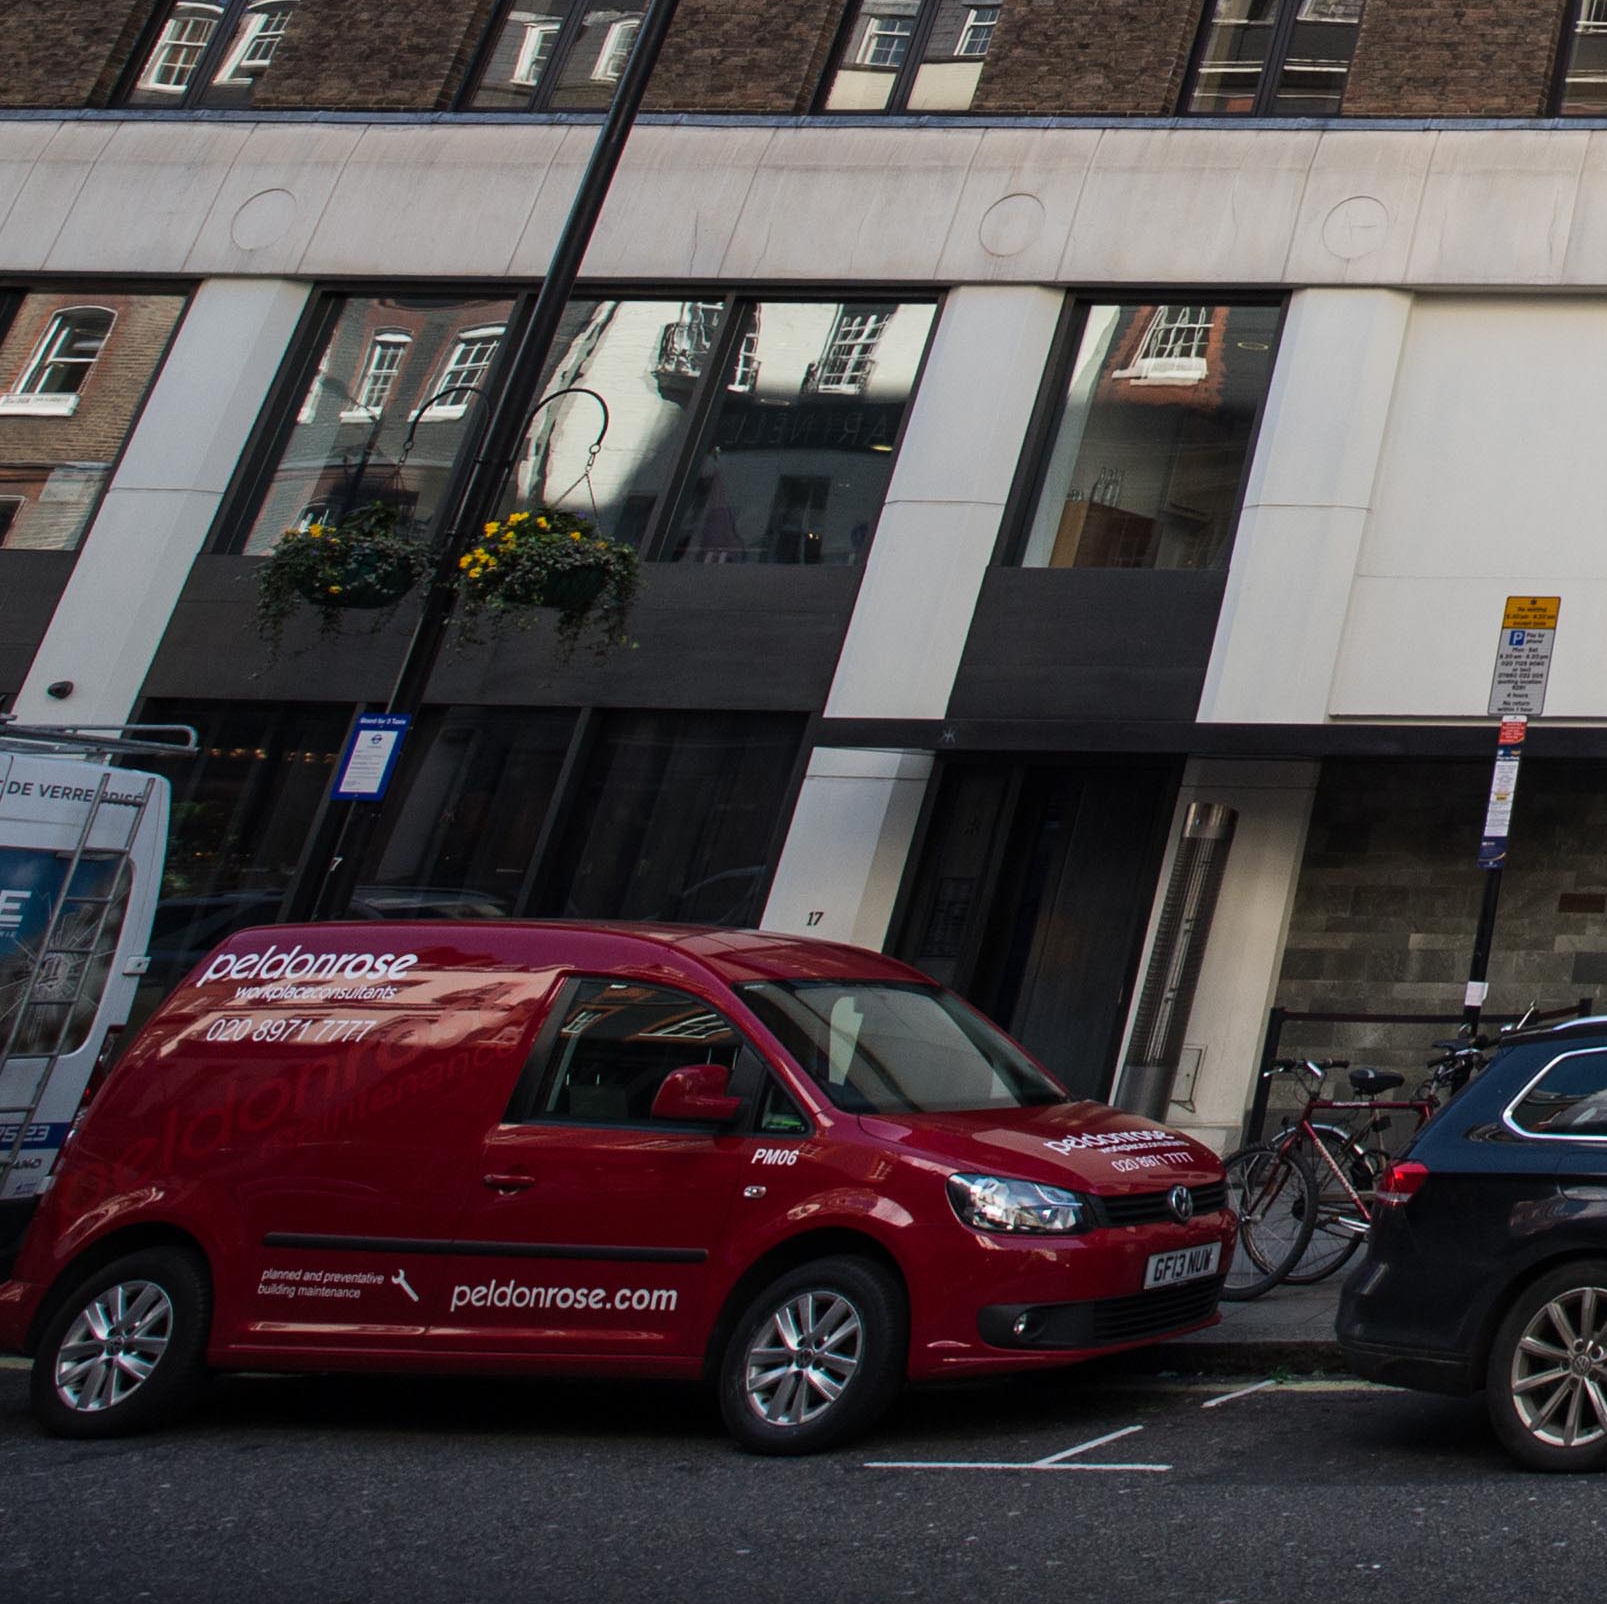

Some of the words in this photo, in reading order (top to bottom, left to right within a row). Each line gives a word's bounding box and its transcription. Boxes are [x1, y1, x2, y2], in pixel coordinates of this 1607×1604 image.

[7, 781, 34, 796] DE
[40, 784, 94, 803] VERRE
[806, 911, 824, 927] 17
[196, 945, 418, 988] peldonrose
[235, 984, 398, 1002] workplaceconsultants
[206, 1018, 252, 1042] 020
[252, 1019, 314, 1042] 8971
[314, 1019, 378, 1043] 7777
[751, 1147, 799, 1166] PM06
[261, 1268, 302, 1281] planned
[302, 1270, 323, 1282] and
[323, 1271, 385, 1284] preventative
[257, 1283, 295, 1298] building
[297, 1285, 361, 1298] maintenance
[450, 1279, 678, 1312] peldonrose.com
